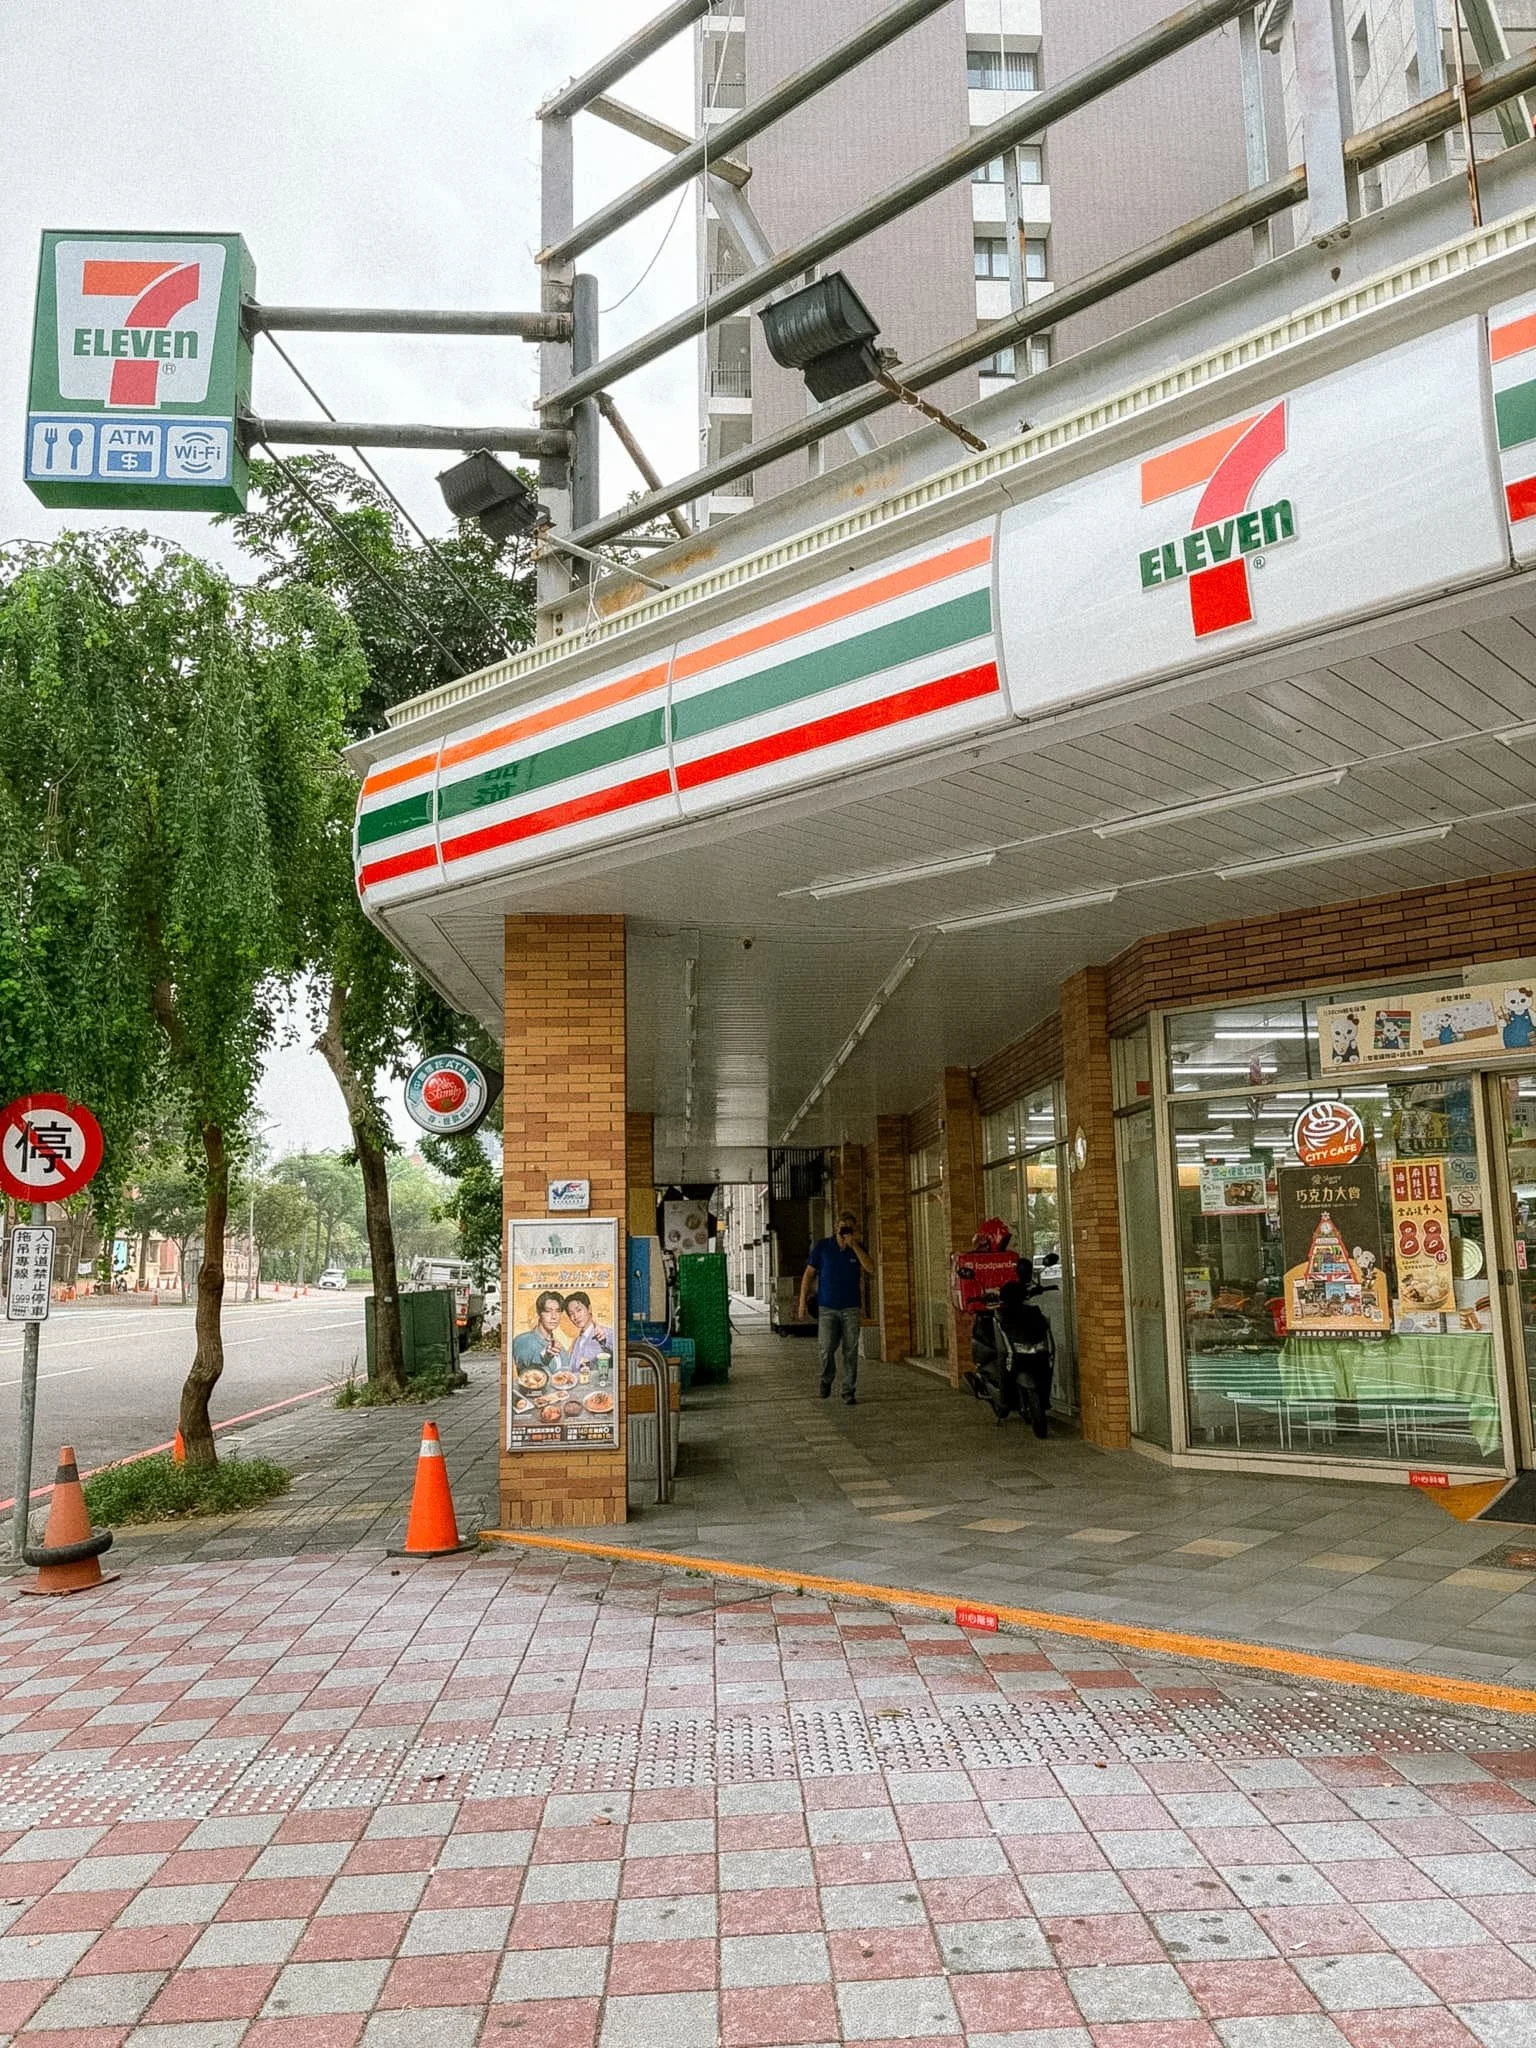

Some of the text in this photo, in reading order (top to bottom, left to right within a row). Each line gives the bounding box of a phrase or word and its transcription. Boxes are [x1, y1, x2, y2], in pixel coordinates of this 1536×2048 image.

[108, 430, 154, 445] ATM
[174, 445, 222, 460] Wi-Fi
[15, 1120, 72, 1174] 停
[1305, 1143, 1358, 1163] CITY CAFE
[31, 1231, 50, 1316] 人行道禁止停車
